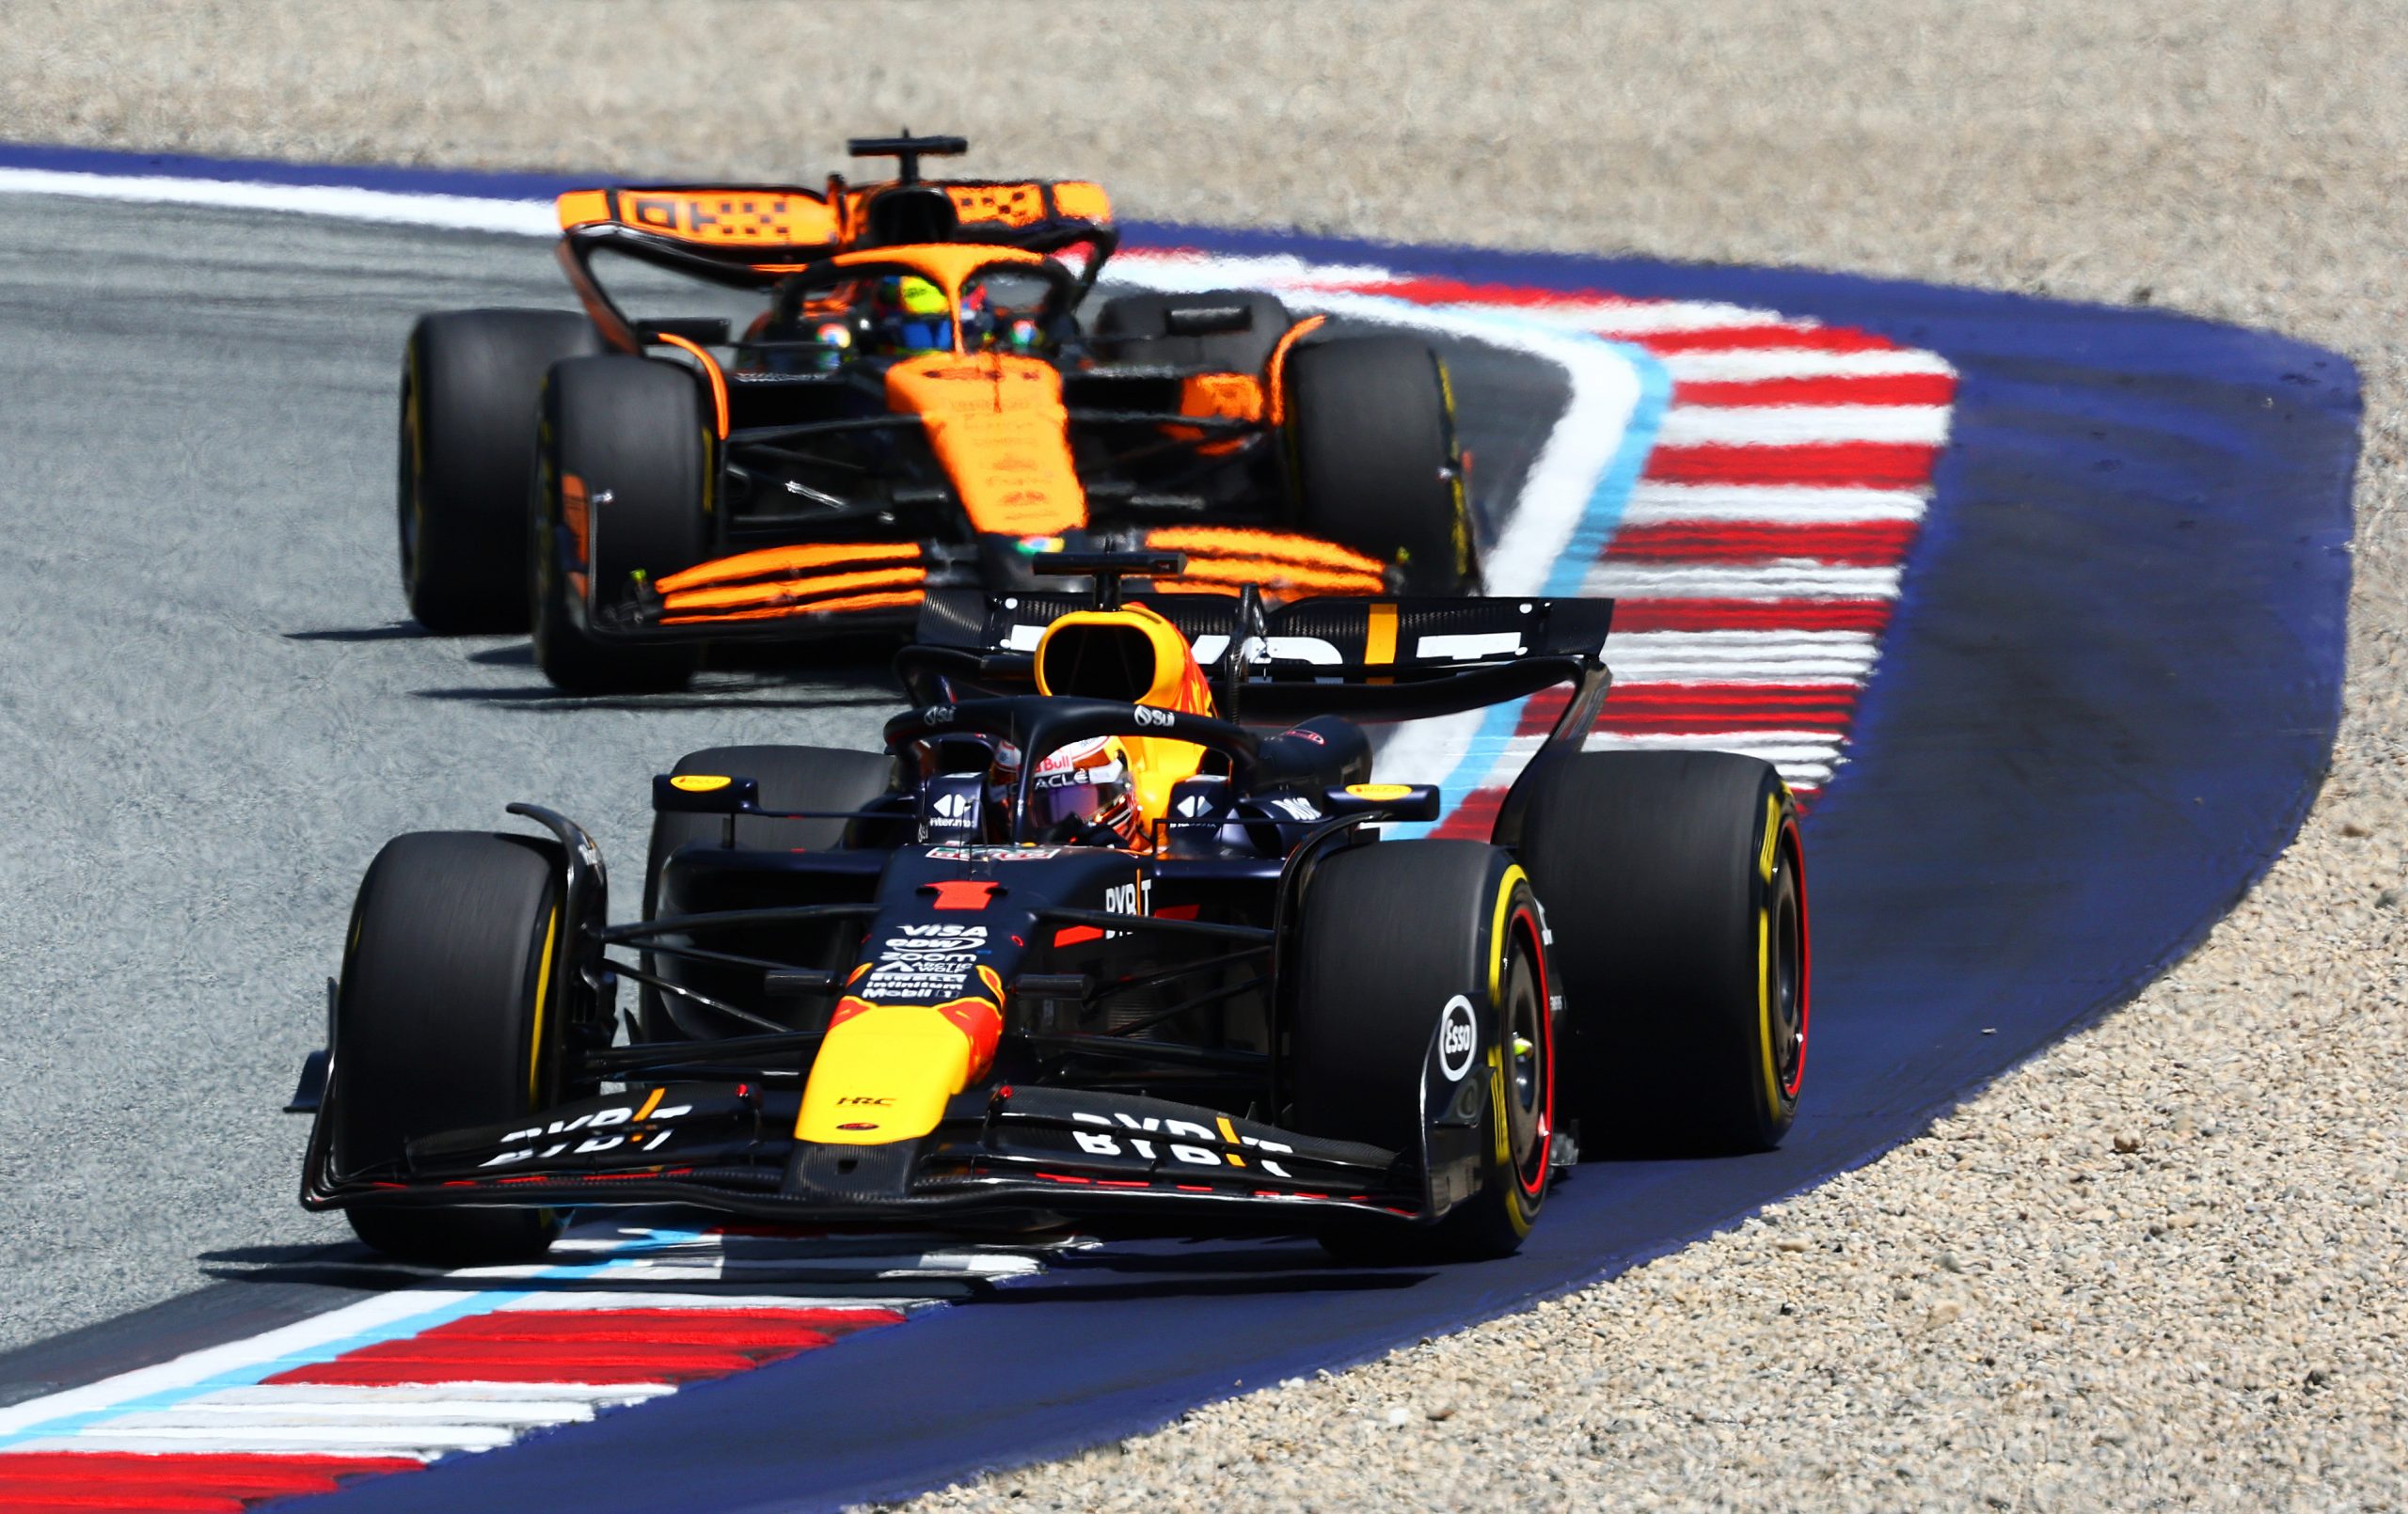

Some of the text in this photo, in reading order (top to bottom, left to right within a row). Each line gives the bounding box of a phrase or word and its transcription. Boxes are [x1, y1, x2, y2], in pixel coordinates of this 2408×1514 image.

[1152, 710, 1174, 727] Sui
[1043, 756, 1069, 771] Bull
[895, 924, 988, 937] VISA
[911, 961, 974, 970] ARCTIC
[862, 988, 932, 998] Mobil
[1445, 1018, 1470, 1054] Esso
[835, 1096, 896, 1108] HRC
